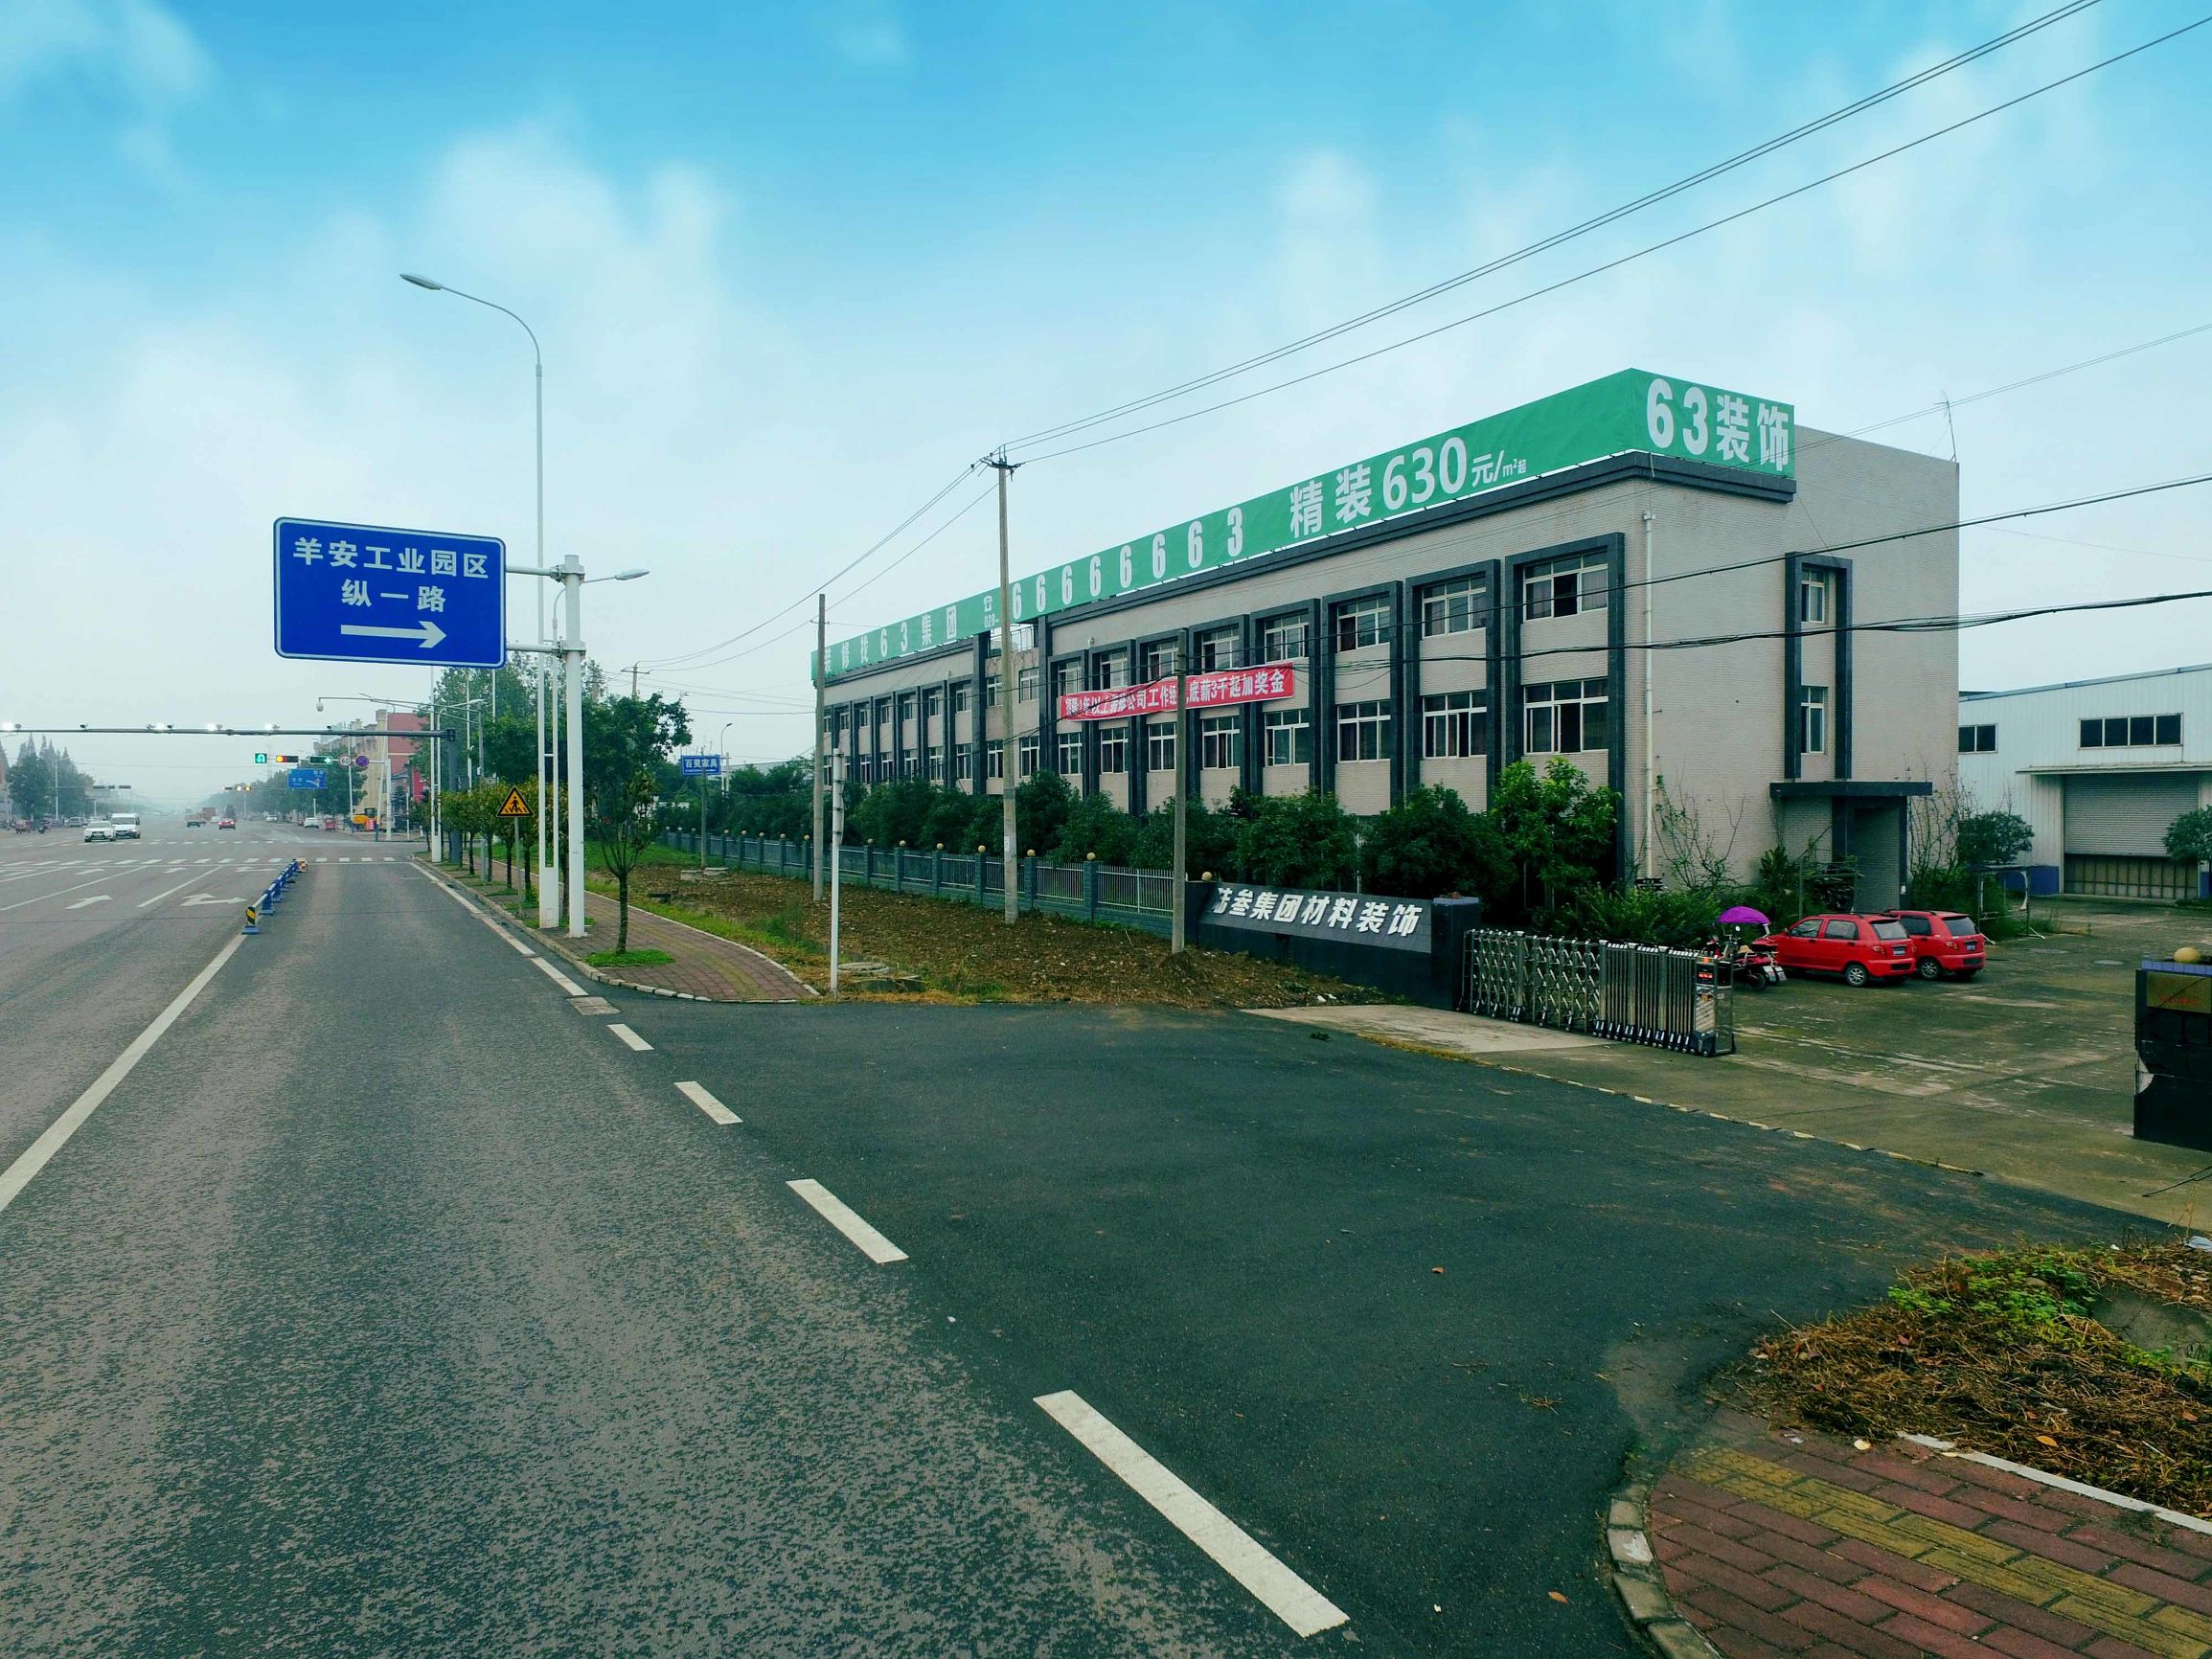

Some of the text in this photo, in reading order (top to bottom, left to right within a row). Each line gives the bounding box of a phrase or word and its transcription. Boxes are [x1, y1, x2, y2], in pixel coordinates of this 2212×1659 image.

[1646, 377, 1790, 472] 63装饰
[293, 537, 489, 579] 羊安工业园区
[1012, 507, 1243, 620] 66666663
[341, 579, 446, 612] 纵一路
